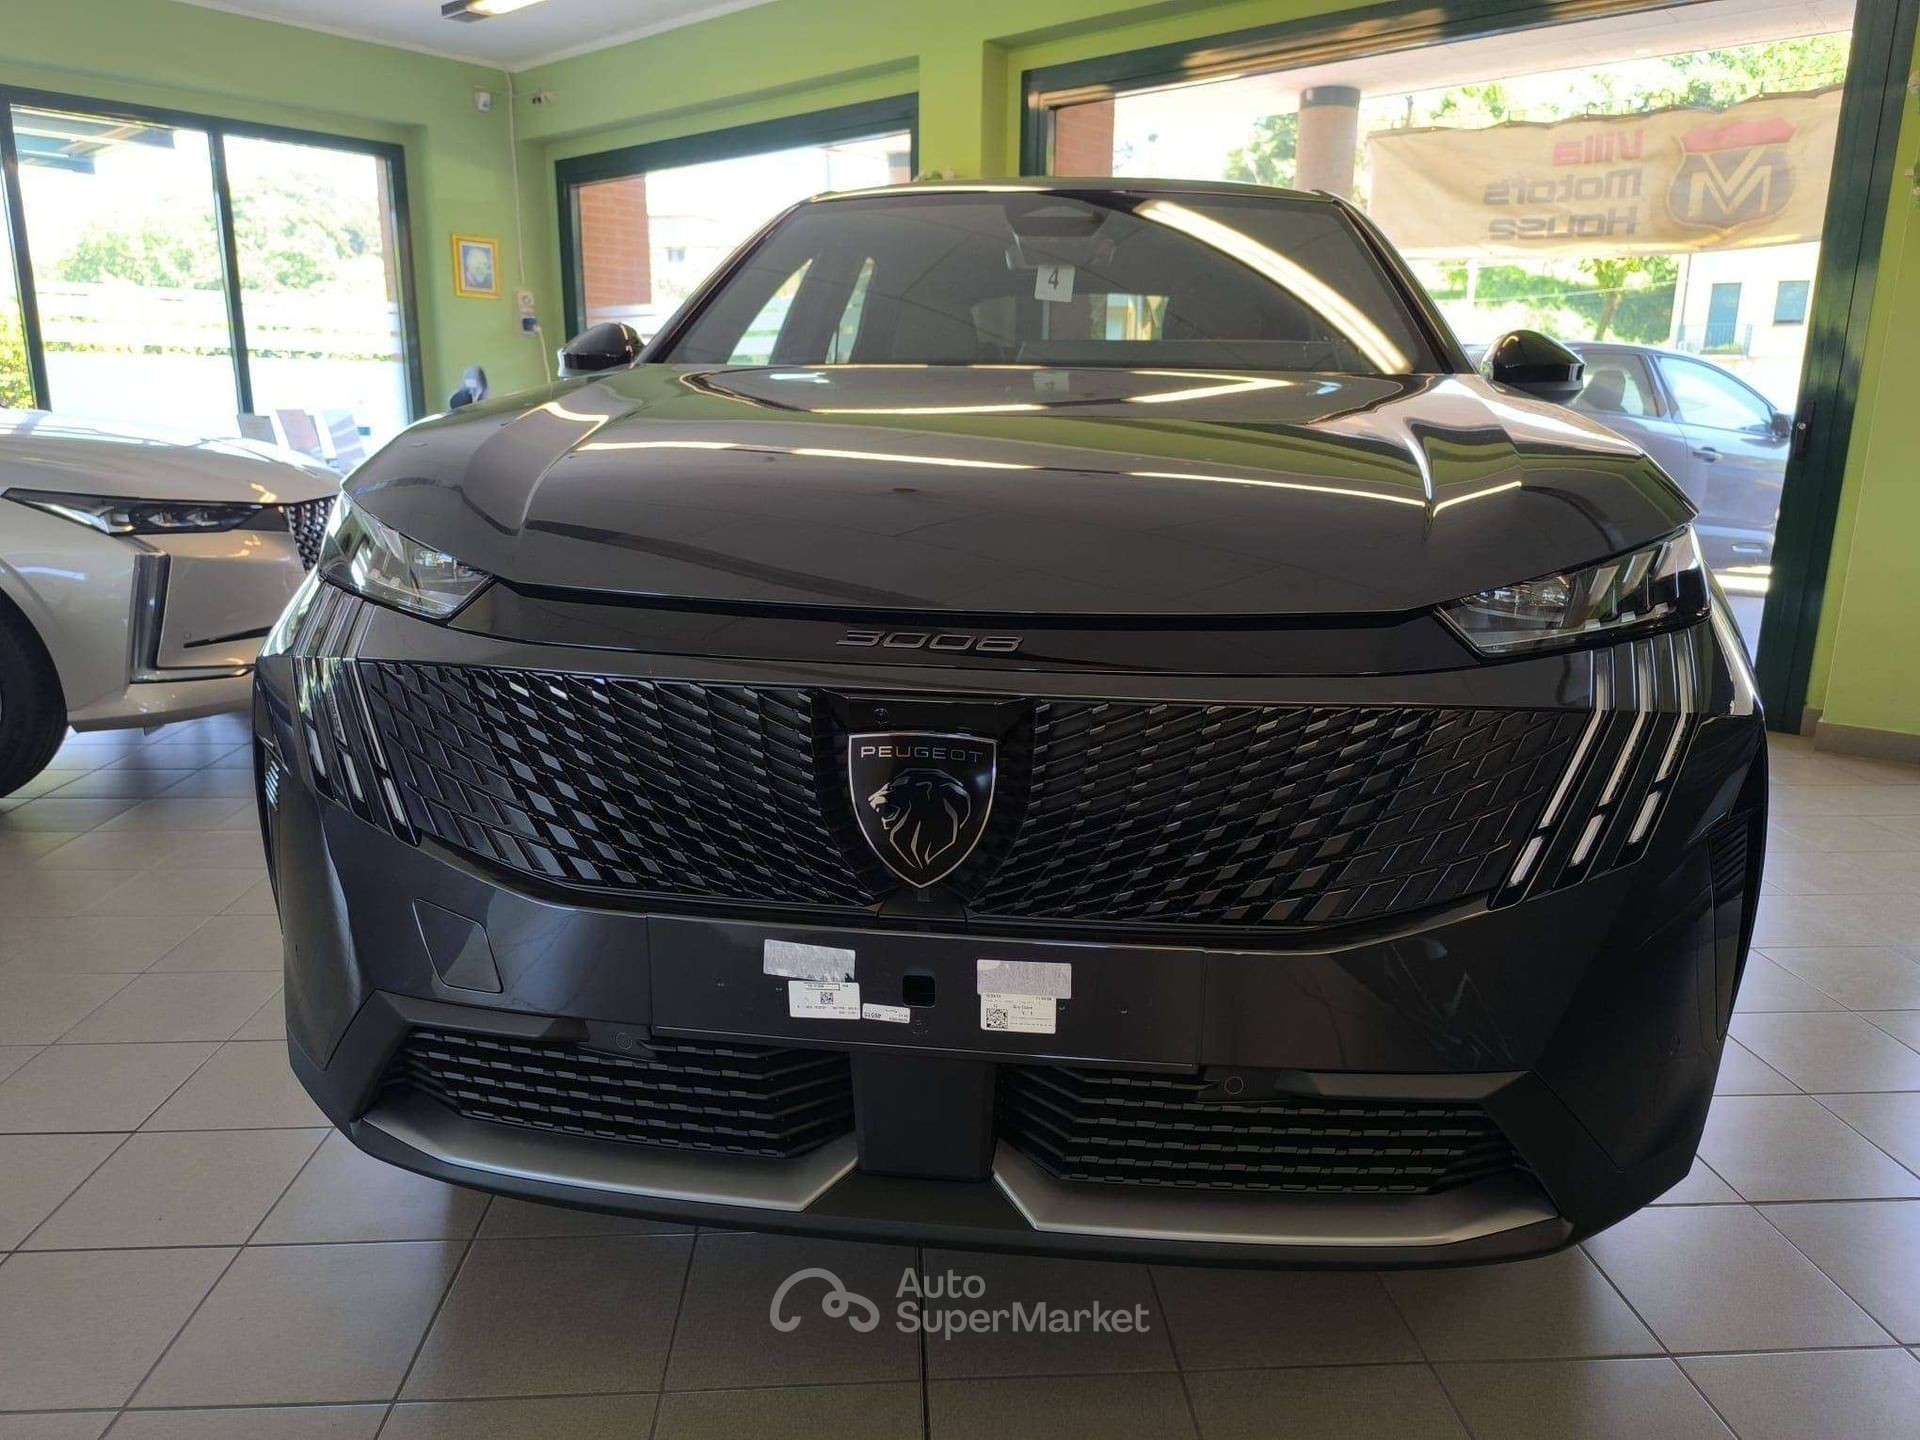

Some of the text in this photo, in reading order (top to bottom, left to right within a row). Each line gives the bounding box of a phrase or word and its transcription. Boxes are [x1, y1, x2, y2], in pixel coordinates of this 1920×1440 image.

[1047, 268, 1059, 290] 4
[836, 629, 1024, 652] 3008
[860, 745, 984, 763] PEUGEOT
